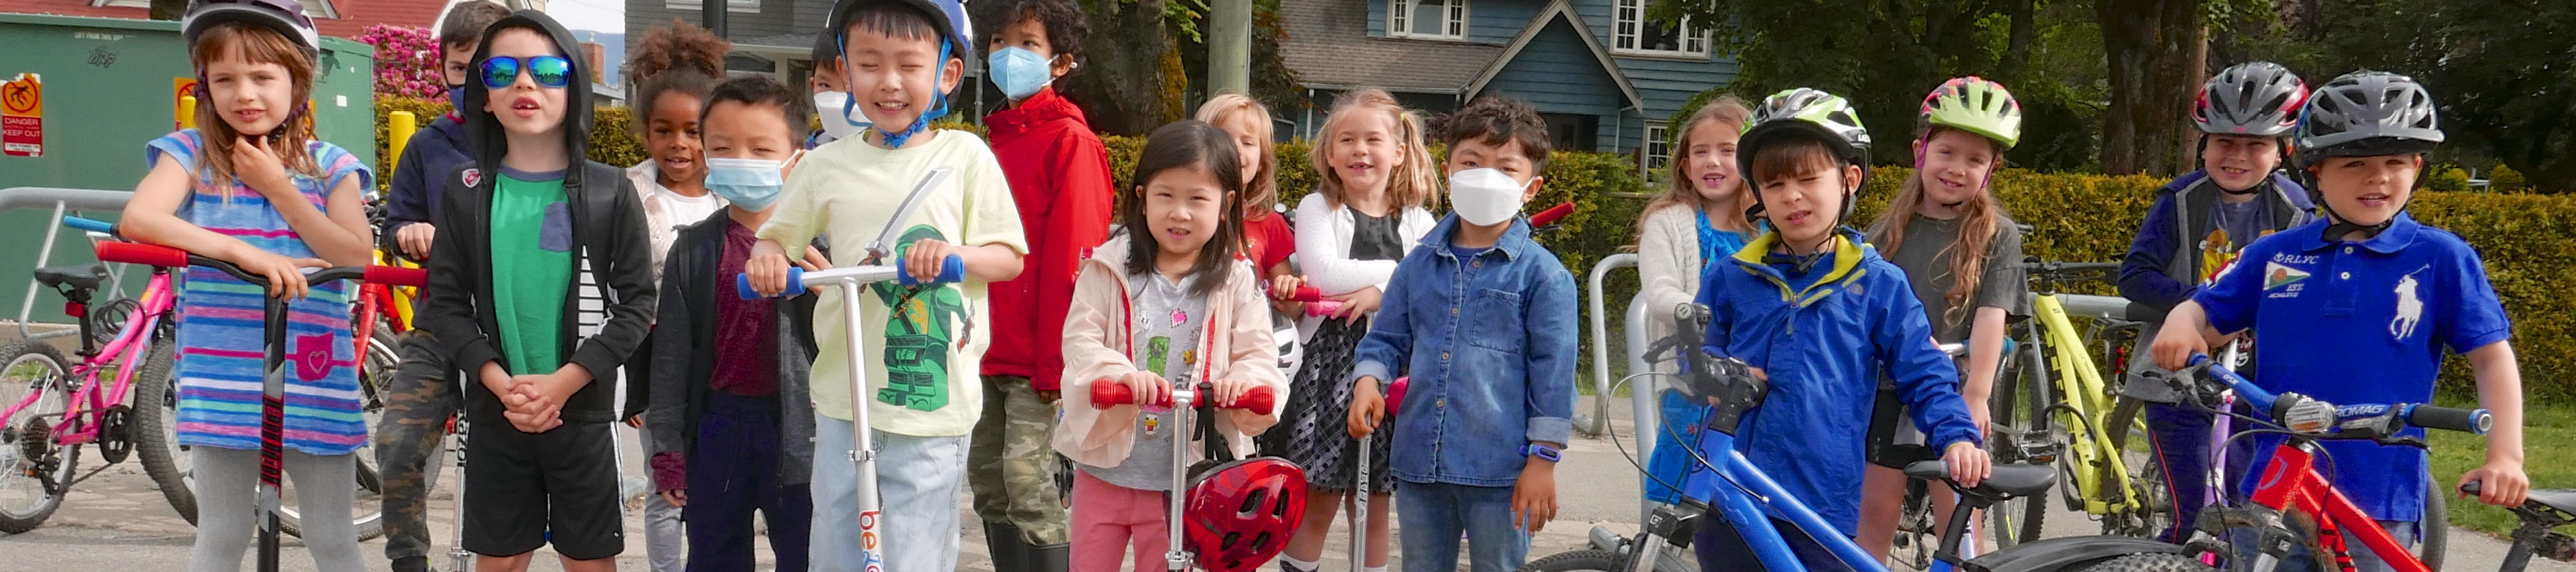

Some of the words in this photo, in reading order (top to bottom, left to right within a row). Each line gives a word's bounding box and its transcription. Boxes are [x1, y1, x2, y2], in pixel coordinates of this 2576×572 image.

[4, 117, 38, 126] DANGER
[3, 128, 23, 137] KEEP
[2283, 254, 2320, 264] RLYC
